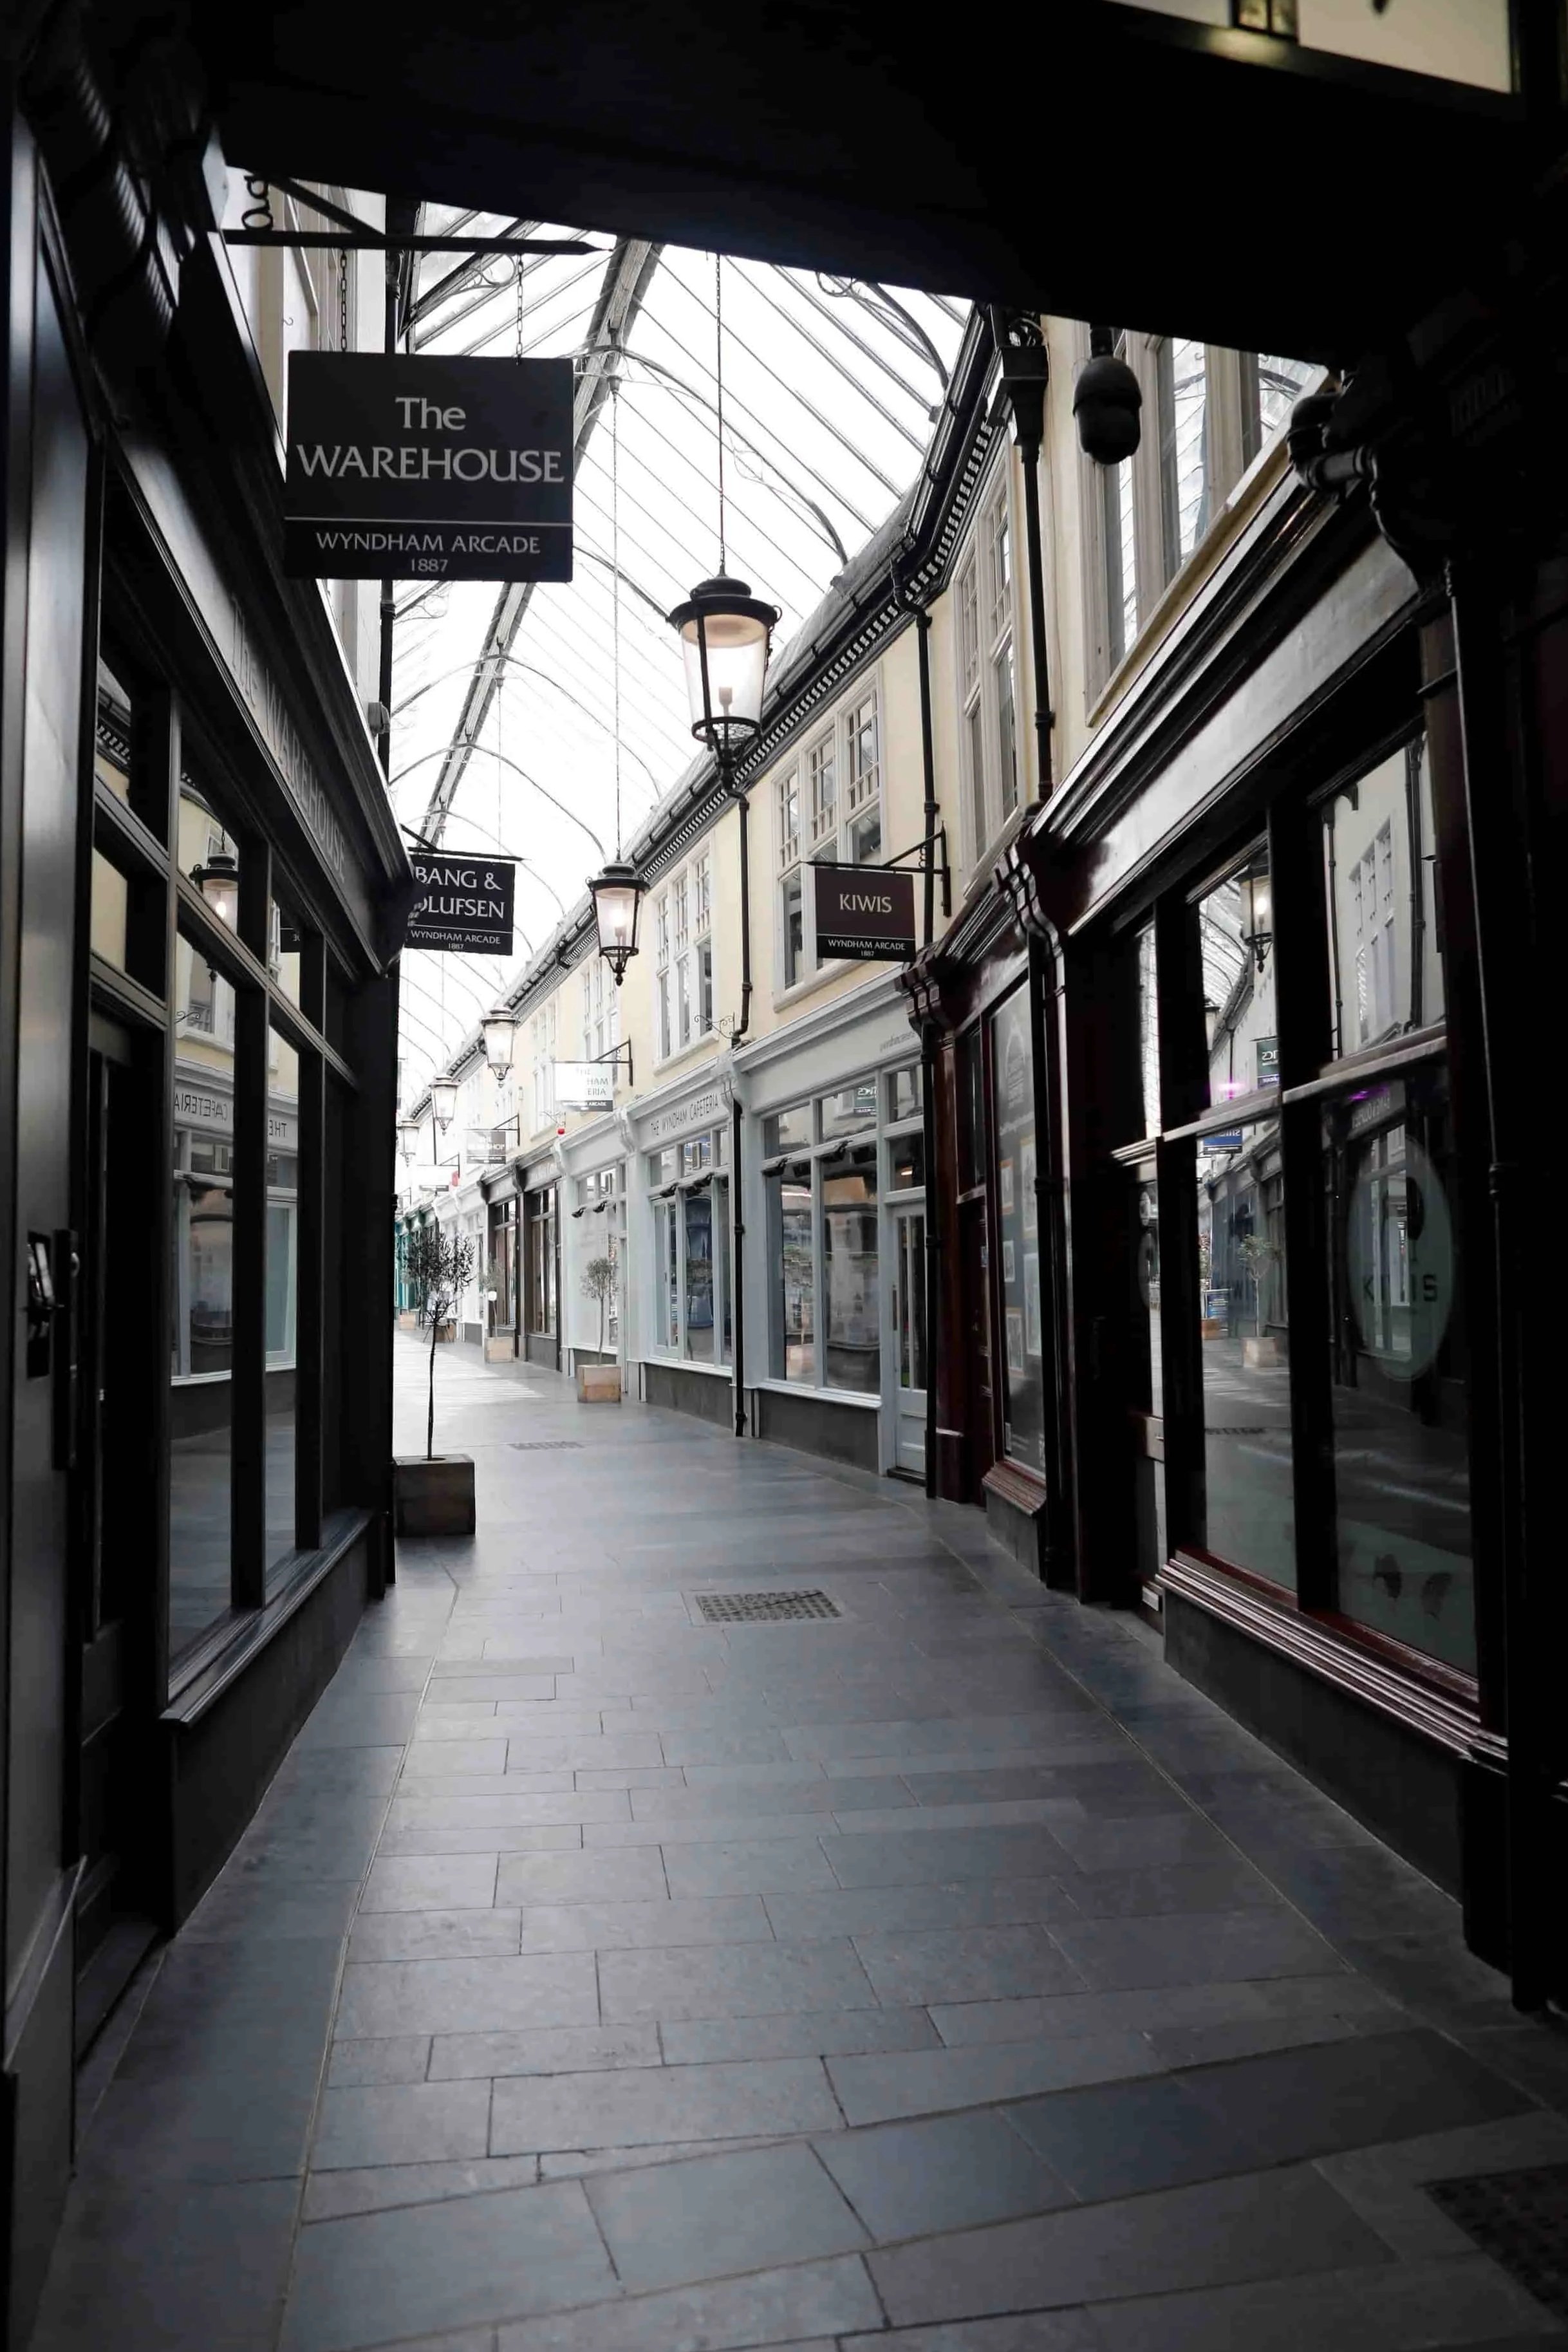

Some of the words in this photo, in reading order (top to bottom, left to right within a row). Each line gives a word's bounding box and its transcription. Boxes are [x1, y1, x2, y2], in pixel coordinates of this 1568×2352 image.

[395, 397, 466, 431] The
[296, 444, 565, 483] WAREHOUSE
[317, 532, 443, 552] WYNDHAM
[452, 535, 540, 554] ARCADE
[410, 559, 449, 573] 1887
[265, 667, 346, 884] WAREHOUSE
[415, 866, 477, 889] BANG
[484, 872, 503, 891] &
[839, 893, 892, 913] KIWIS
[411, 930, 462, 942] WYNDHAM
[465, 933, 501, 944] ARCADE
[828, 939, 872, 949] WYNDHAM
[875, 941, 906, 951] ARCADE
[650, 1120, 659, 1137] THE
[662, 1108, 687, 1132] WYNDHAM
[690, 1093, 719, 1121] CAFETERIA
